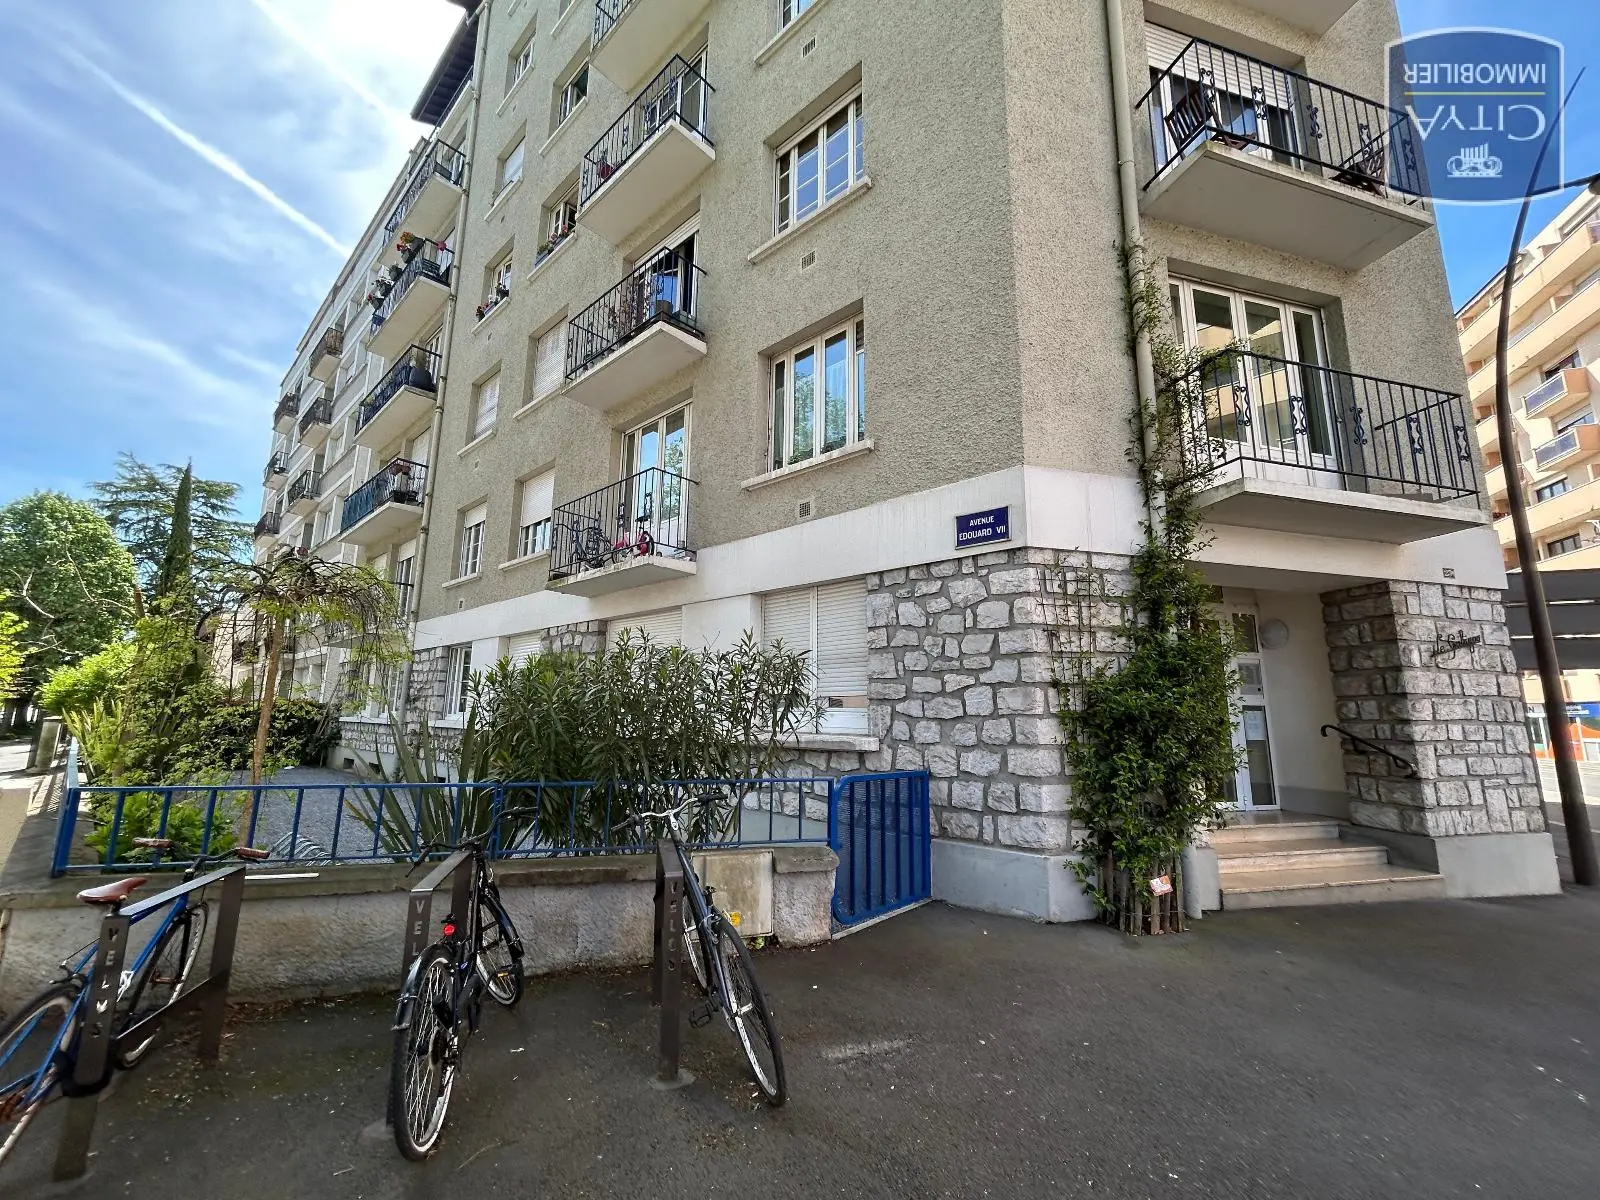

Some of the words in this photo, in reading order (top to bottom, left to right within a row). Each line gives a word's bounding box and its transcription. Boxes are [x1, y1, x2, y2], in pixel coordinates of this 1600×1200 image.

[969, 516, 995, 527] AVENUE
[959, 528, 992, 541] EDOUARD
[995, 525, 1006, 534] VII
[413, 900, 425, 956] VEL
